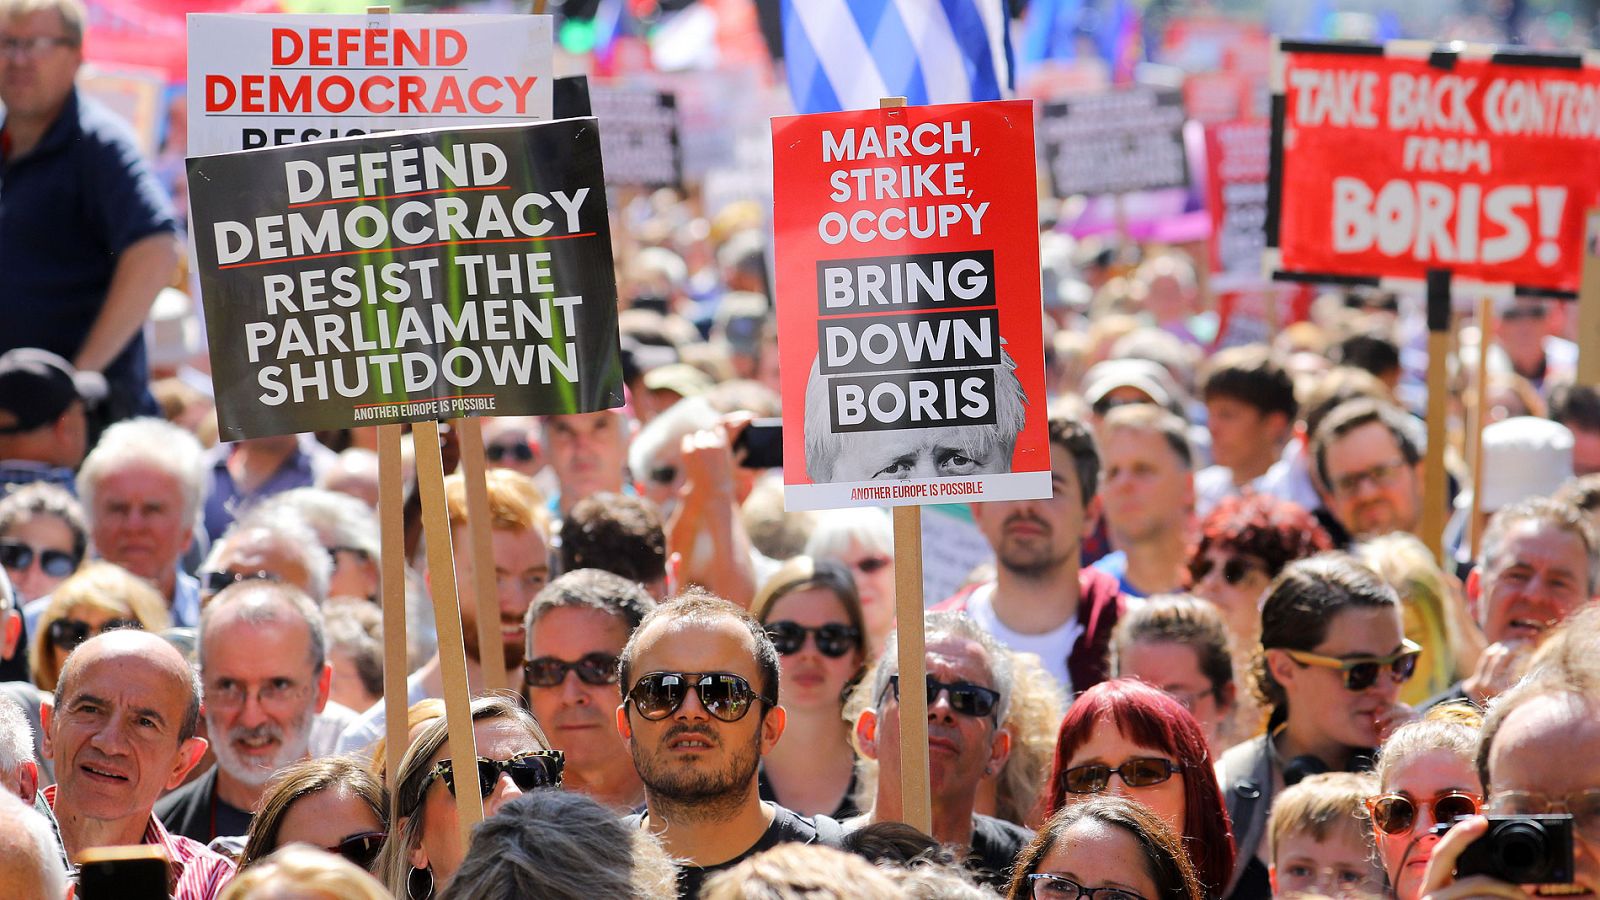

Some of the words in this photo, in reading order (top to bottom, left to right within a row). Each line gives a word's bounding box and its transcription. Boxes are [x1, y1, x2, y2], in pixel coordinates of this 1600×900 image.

[271, 28, 468, 66] DEFEND
[205, 75, 538, 113] DEMOCRACY
[1291, 69, 1380, 129] TAKE
[1388, 73, 1478, 134] BACK
[1483, 78, 1600, 138] CONTRO
[821, 120, 980, 163] MARCH,
[1403, 136, 1491, 174] FROM
[285, 143, 508, 204] DEFEND
[829, 163, 974, 203] STRIKE,
[213, 188, 591, 265] DEMOCRACY
[818, 202, 990, 244] OCCUPY
[1332, 177, 1567, 266] BORIS!
[263, 258, 439, 315] RESIST
[454, 252, 555, 297] THE
[824, 258, 988, 308] BRING
[245, 295, 583, 363] PARLIAMENT
[826, 317, 993, 367] DOWN
[257, 342, 580, 406] SHUTDOWN
[354, 405, 399, 420] ANOTHER
[400, 401, 438, 417] EUROPE
[440, 400, 450, 412] IS
[452, 397, 496, 411] POSSIBLE
[837, 377, 990, 426] BORIS
[851, 486, 891, 500] ANOTHER
[893, 484, 927, 499] EUROPE
[930, 483, 938, 497] IS
[940, 481, 983, 496] POSSIBLE
